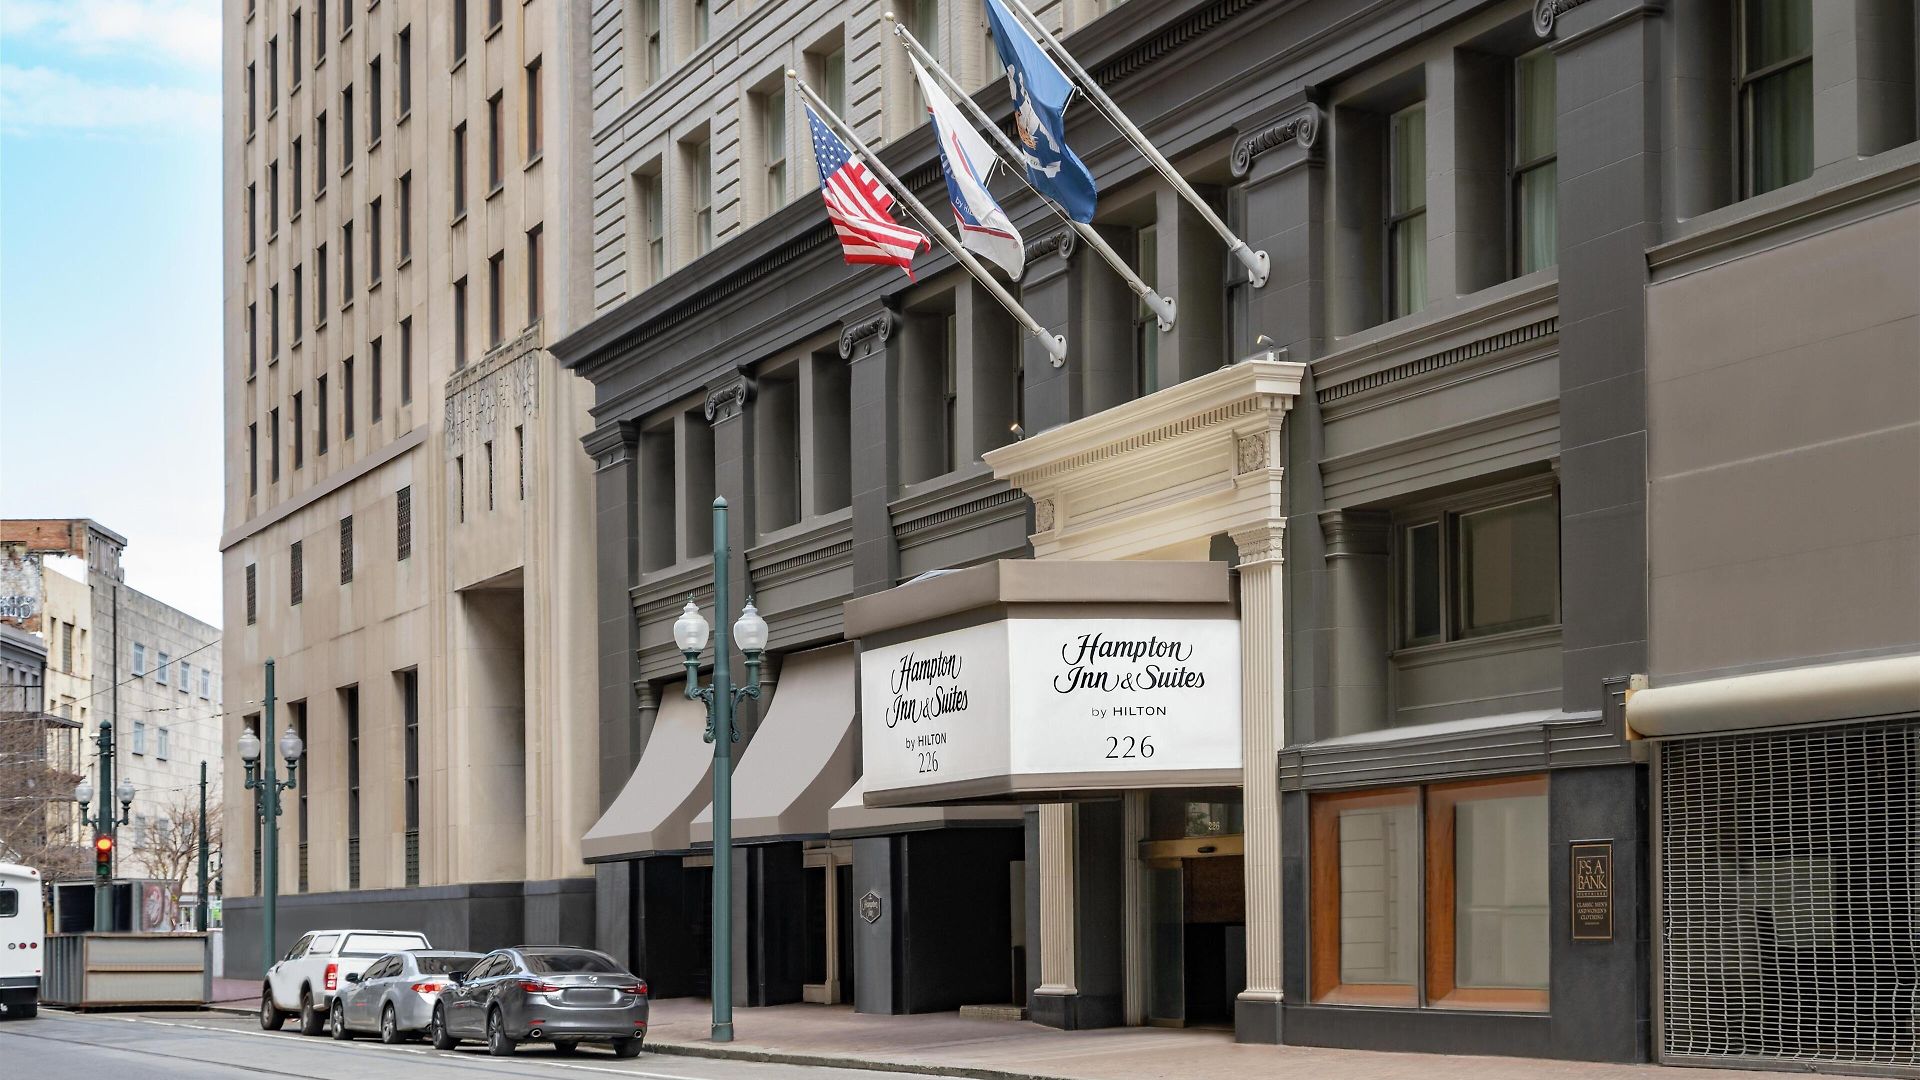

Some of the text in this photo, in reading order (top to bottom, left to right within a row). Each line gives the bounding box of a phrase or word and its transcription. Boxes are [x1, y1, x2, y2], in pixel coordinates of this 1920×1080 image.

[1062, 632, 1193, 666] Hampton
[891, 650, 962, 695] Hampton
[1053, 664, 1206, 694] Inn & Suites
[886, 685, 969, 728] Inn & Suites
[1091, 706, 1167, 719] by HILTON
[905, 732, 947, 752] by HILTON
[1105, 735, 1155, 759] 226
[918, 750, 939, 774] 226
[1578, 875, 1606, 889] BANK
